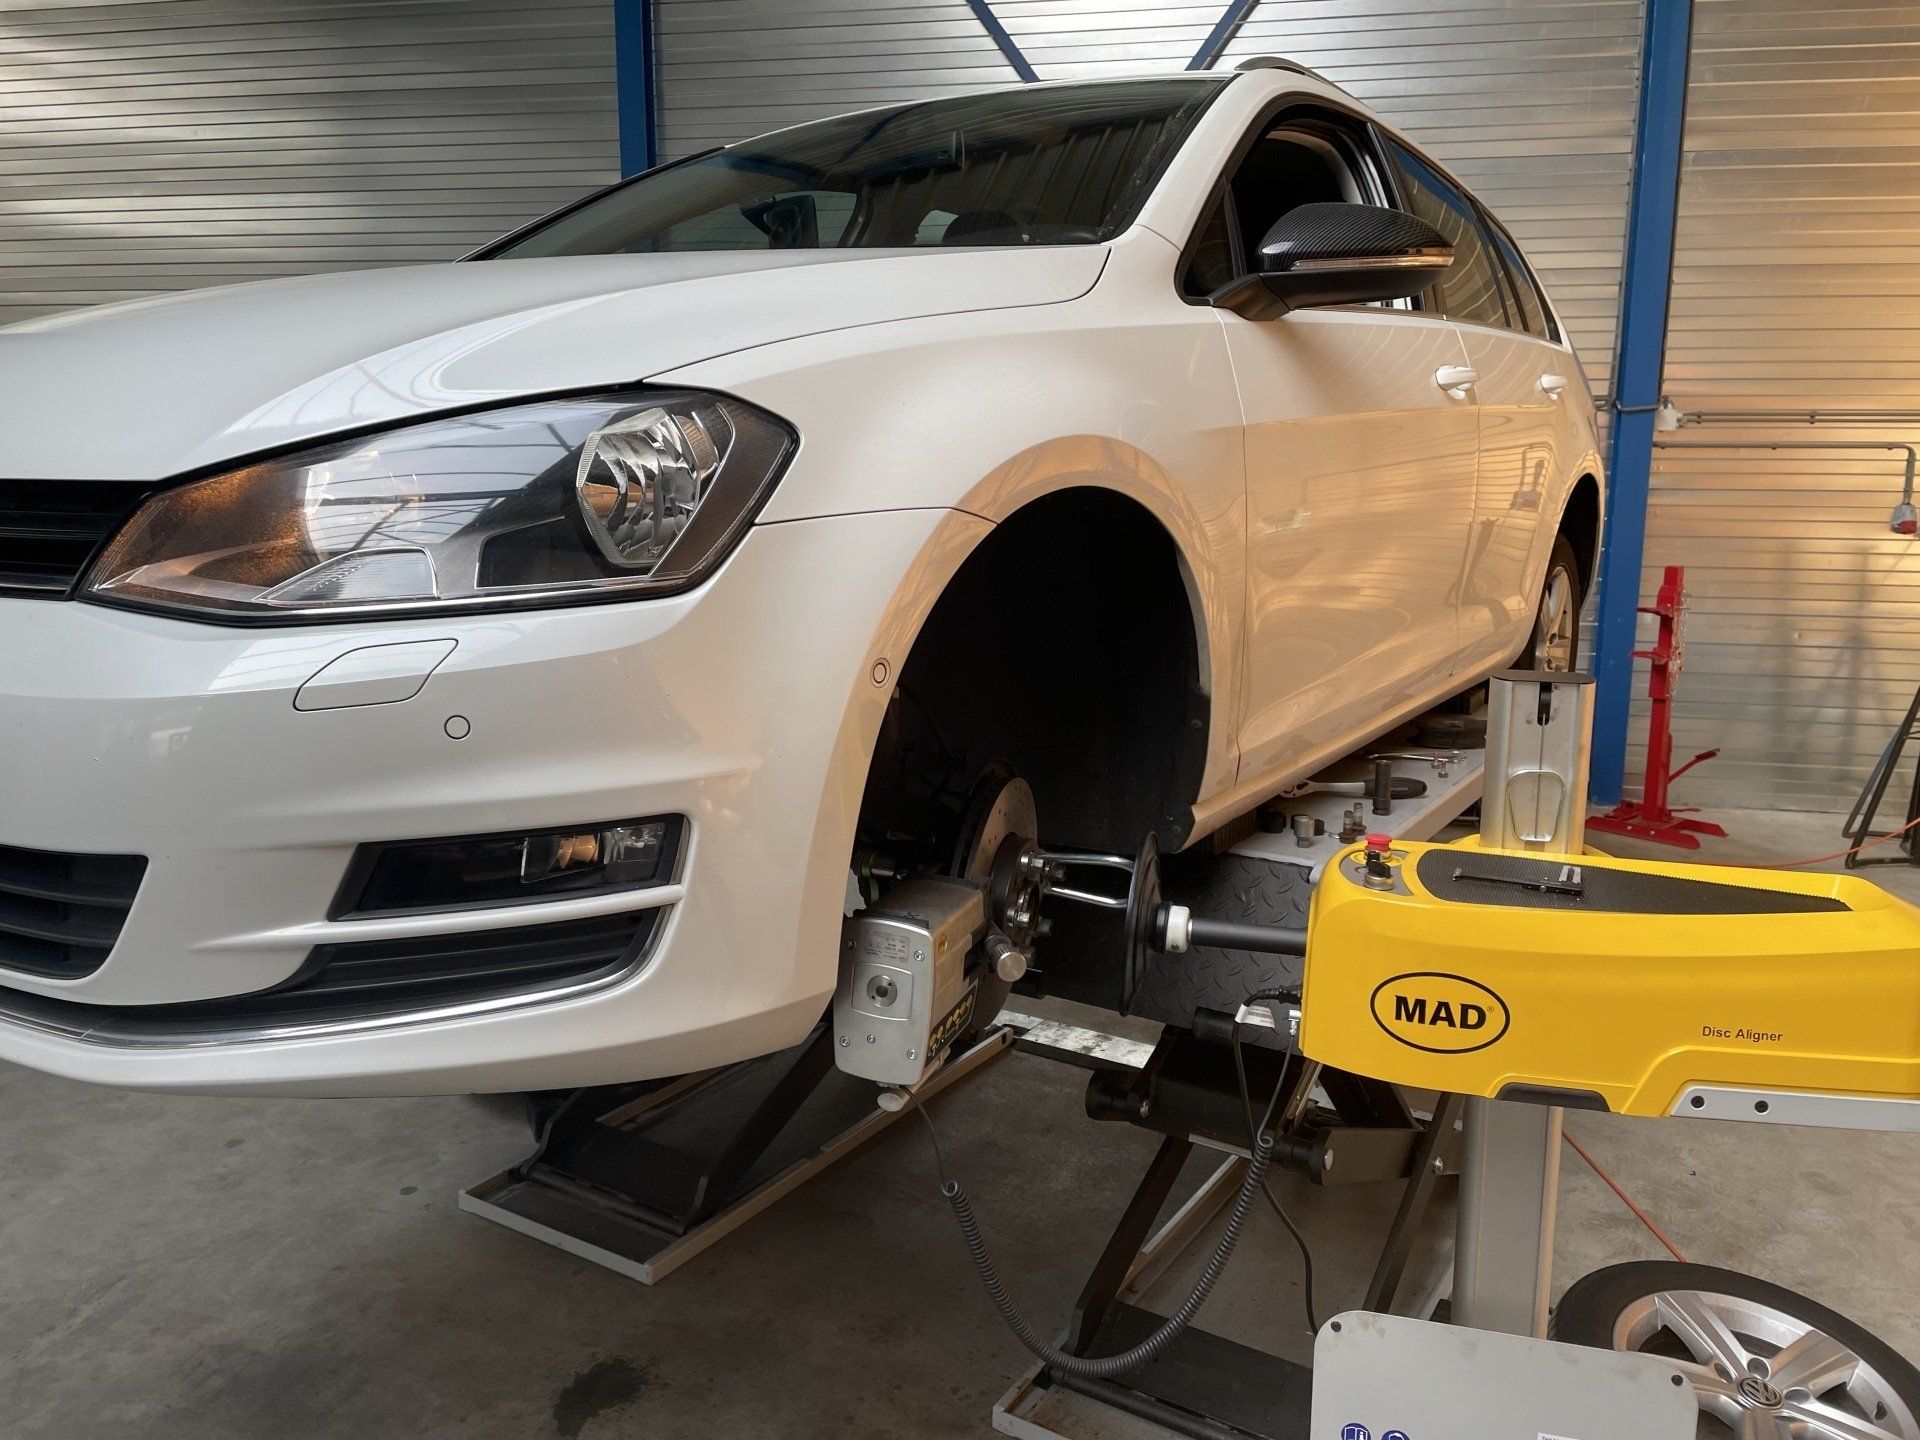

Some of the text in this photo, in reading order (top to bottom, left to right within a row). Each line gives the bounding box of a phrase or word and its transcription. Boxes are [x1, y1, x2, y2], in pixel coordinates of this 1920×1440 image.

[1394, 994, 1486, 1030] MAD
[1702, 1026, 1783, 1042] Disc Aligner
